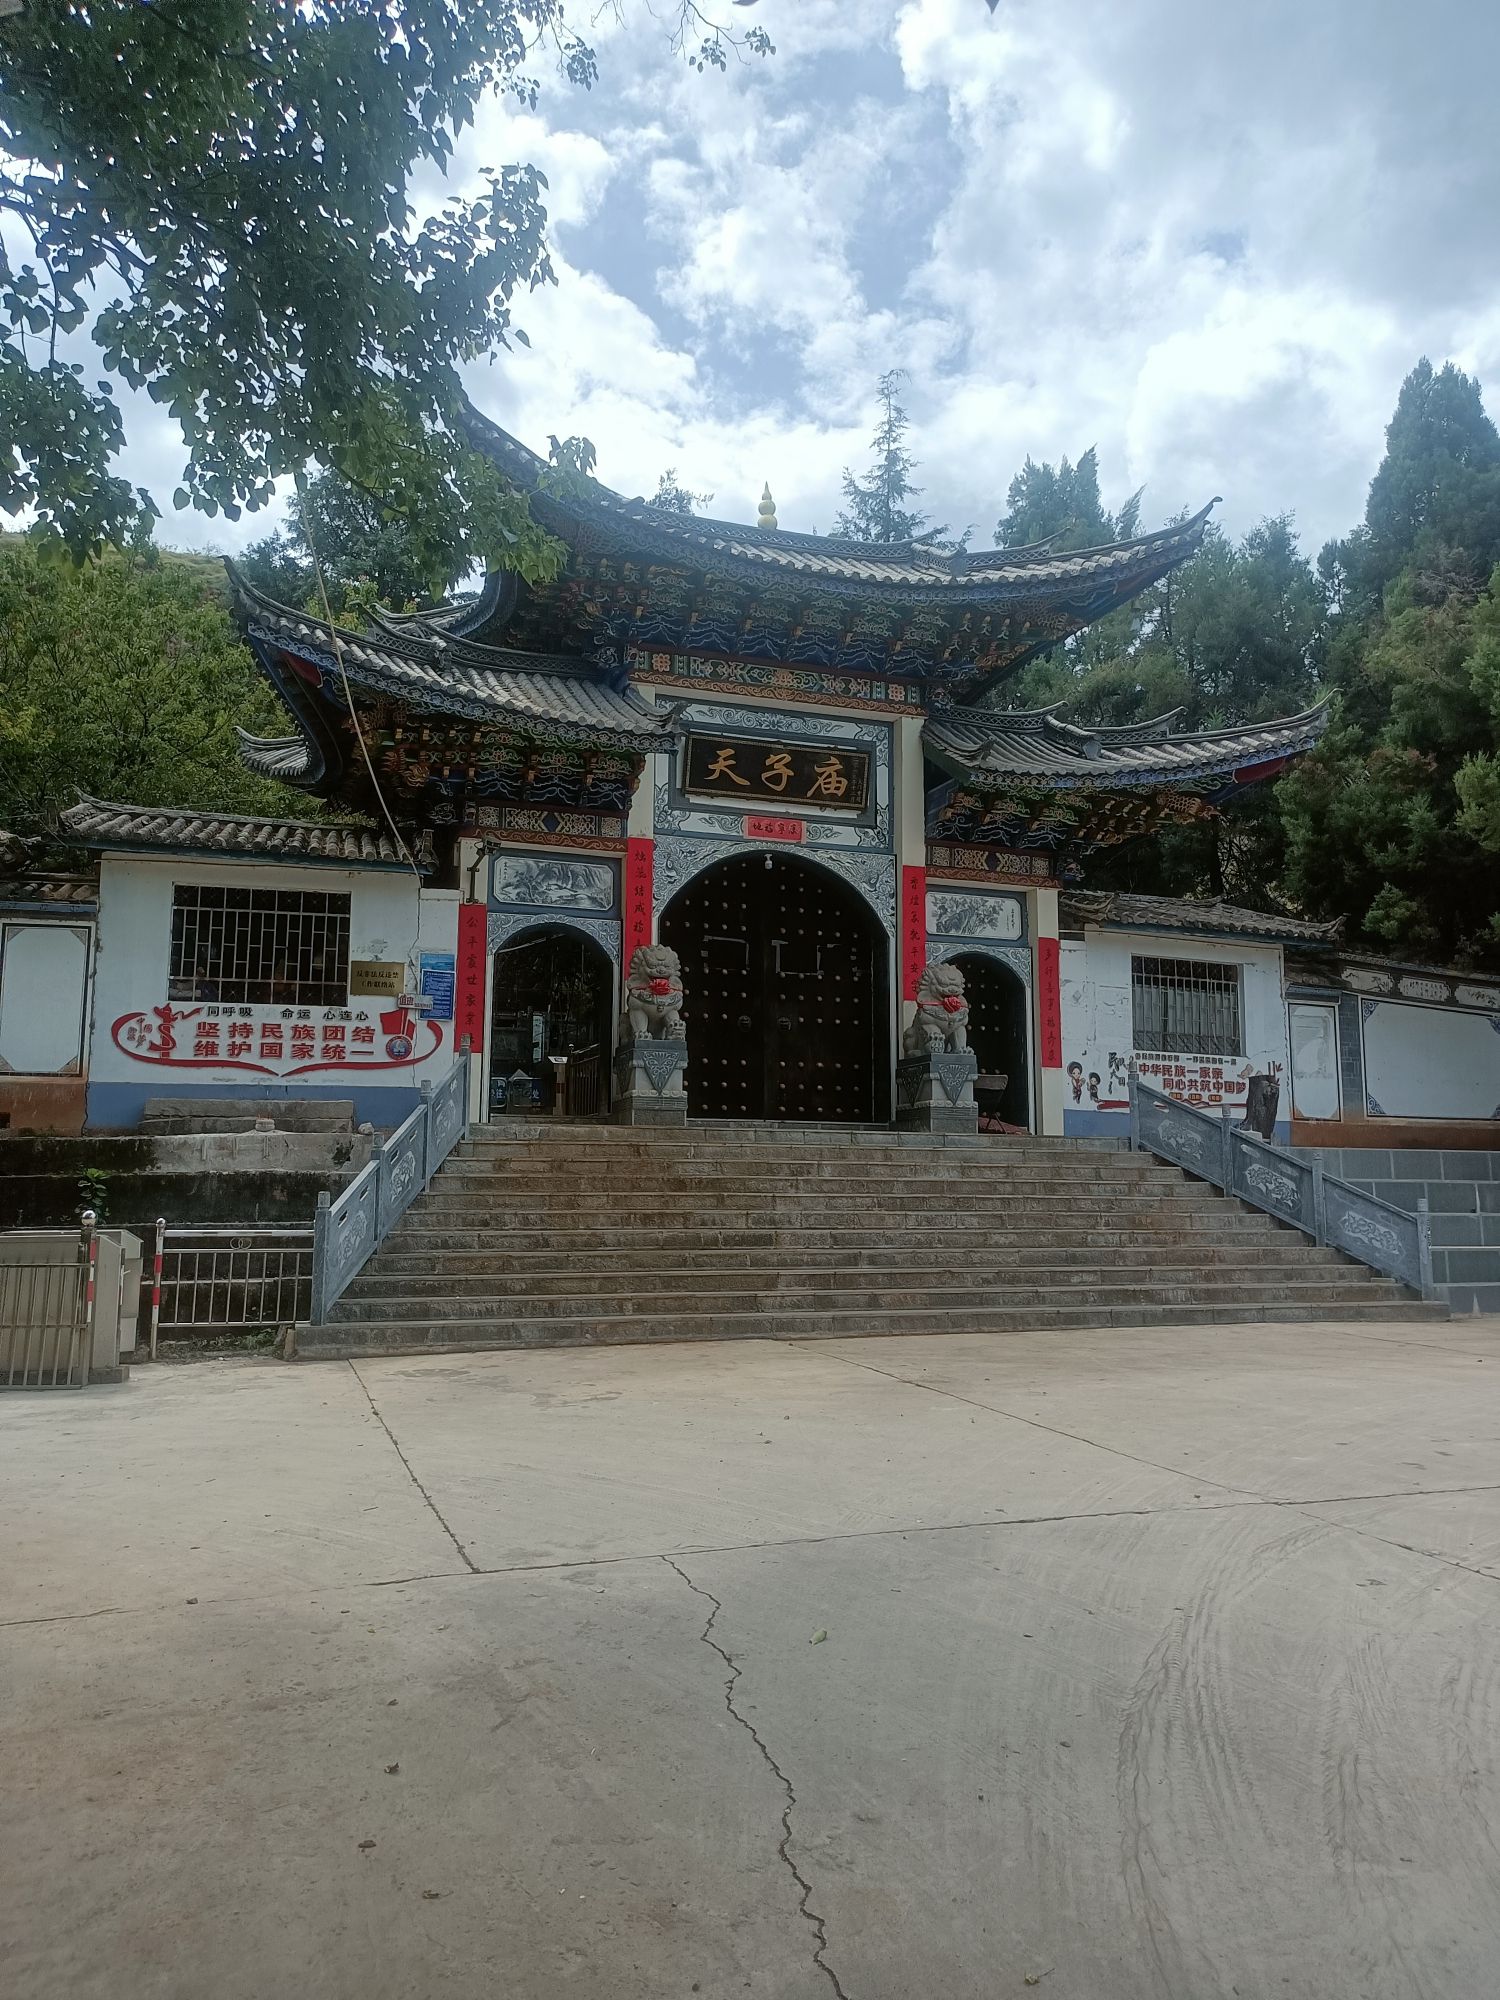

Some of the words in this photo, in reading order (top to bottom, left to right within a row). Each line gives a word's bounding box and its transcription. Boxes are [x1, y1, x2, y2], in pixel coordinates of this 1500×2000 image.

[704, 748, 850, 798] 天子庙
[207, 1006, 254, 1018] 同呼吸
[281, 1008, 311, 1021] 命运
[323, 1009, 369, 1021] 心连心
[193, 1021, 376, 1044] 坚持民族团结
[193, 1040, 375, 1061] 维护国家统一
[1139, 1062, 1224, 1080] 中华民族一家亲
[1162, 1077, 1247, 1095] 同心共筑中国梦
